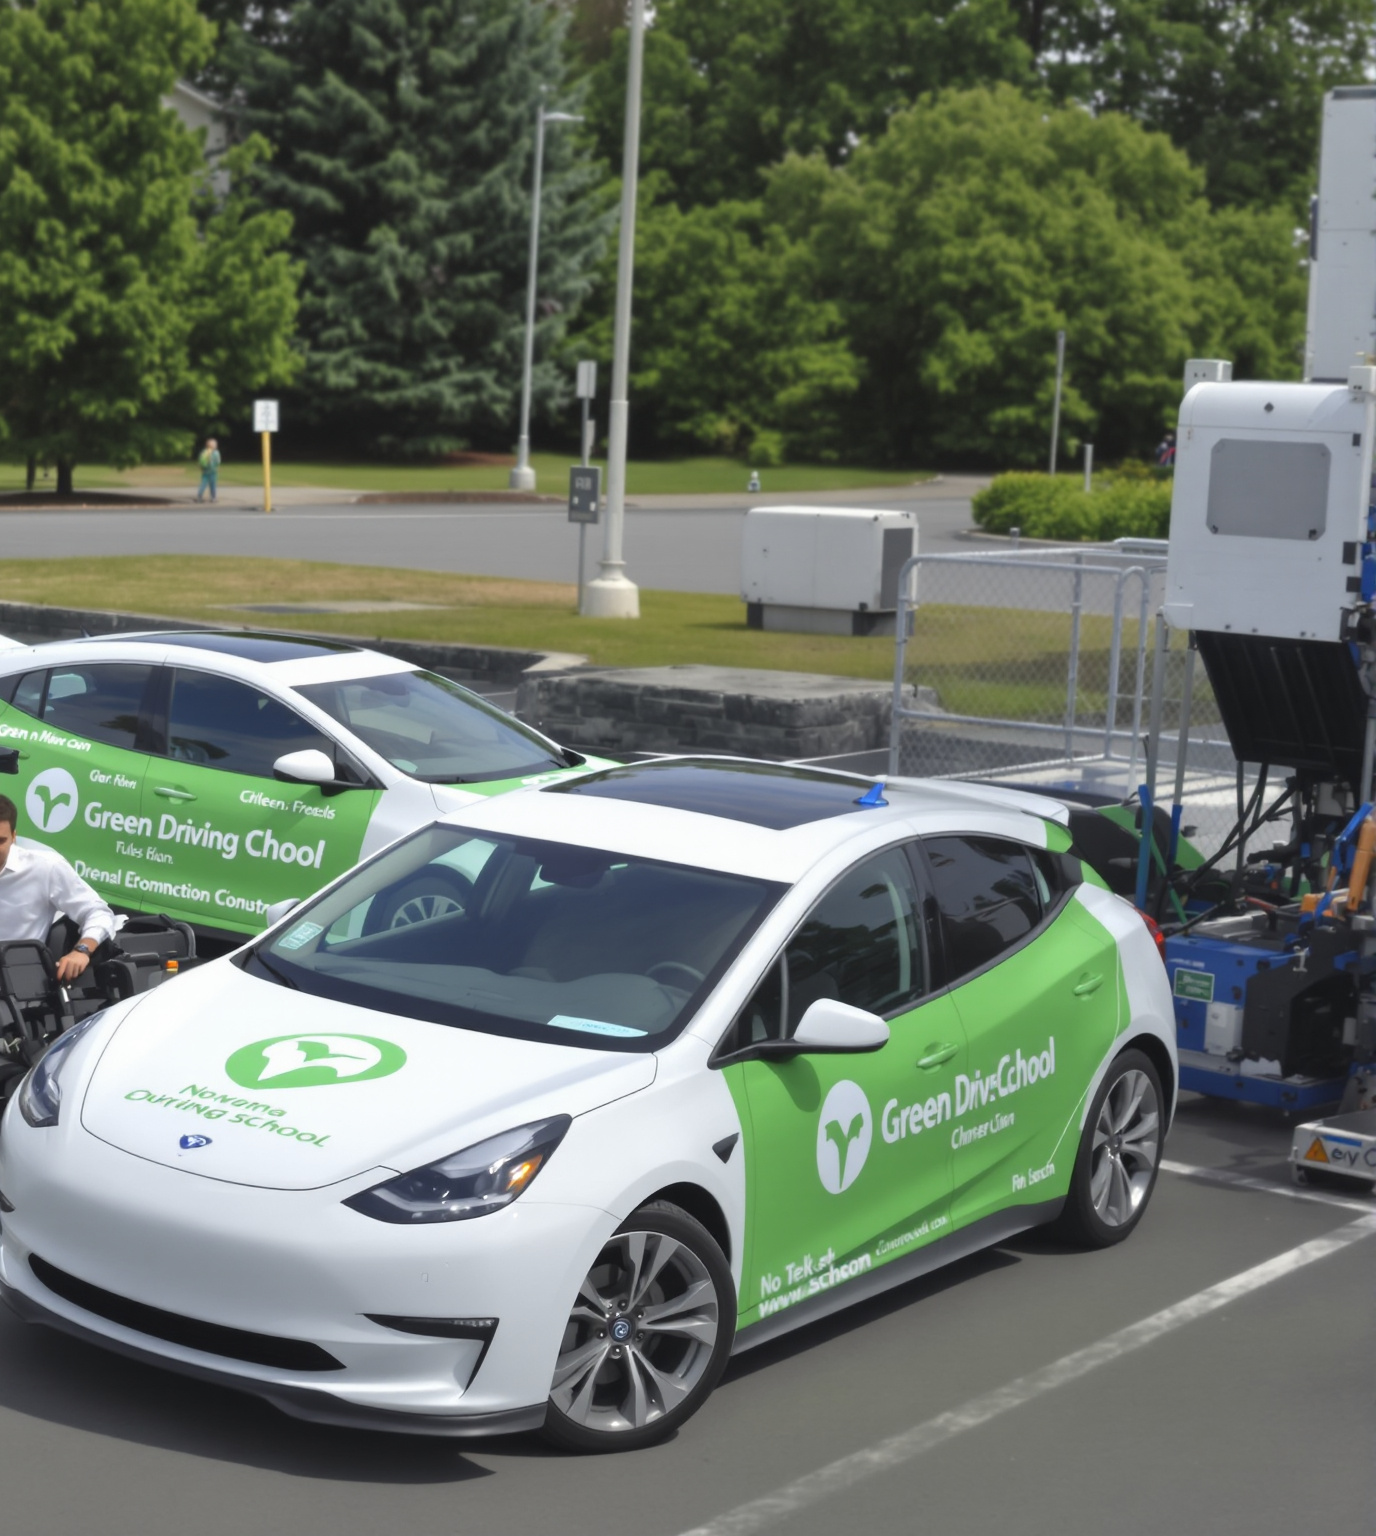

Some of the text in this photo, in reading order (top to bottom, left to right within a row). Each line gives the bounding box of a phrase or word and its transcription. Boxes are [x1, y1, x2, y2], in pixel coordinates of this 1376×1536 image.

[84, 801, 326, 869] Green Driving Chool
[881, 1092, 951, 1144] Green
[761, 1273, 781, 1300] No
